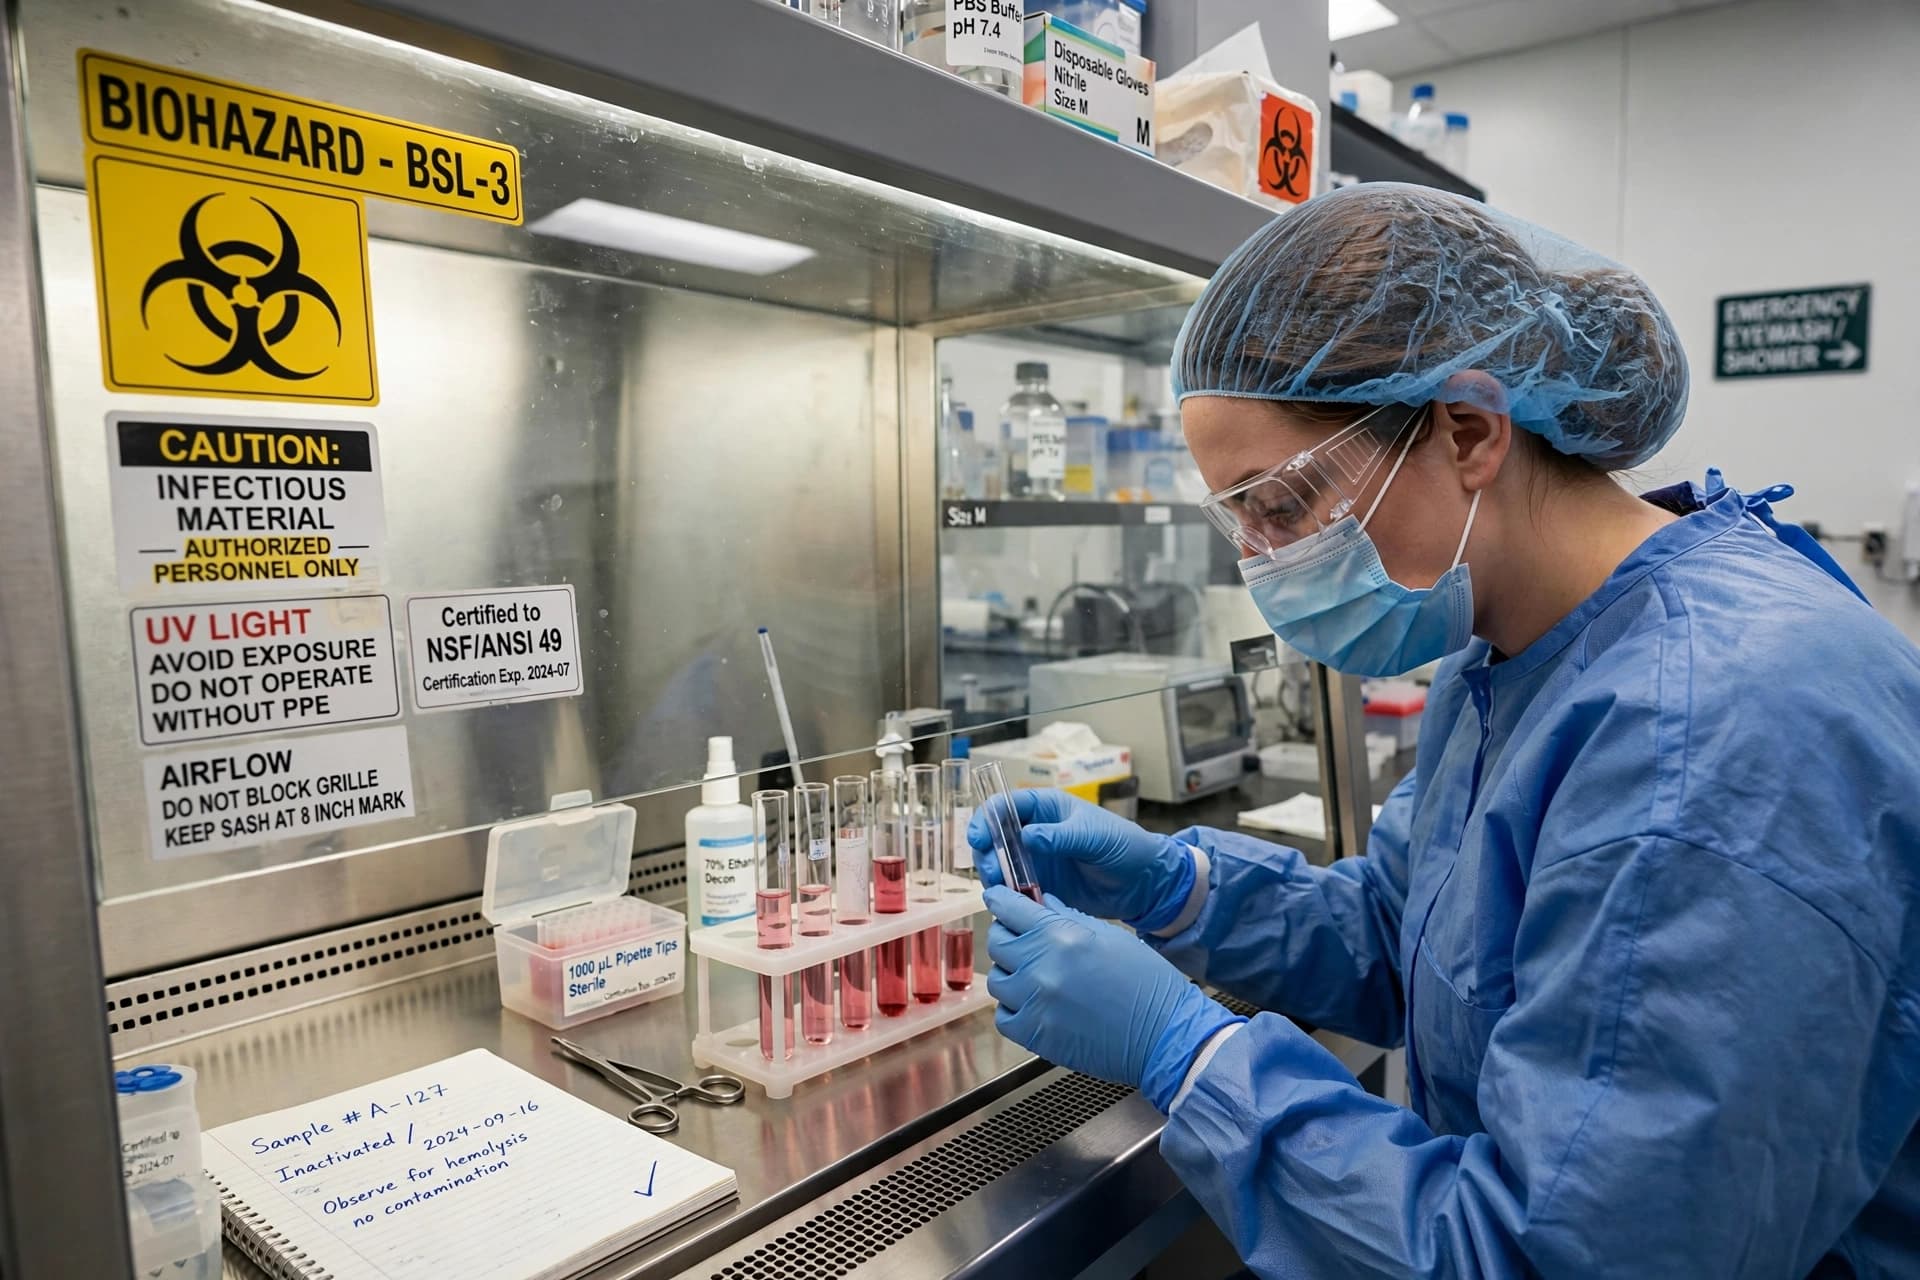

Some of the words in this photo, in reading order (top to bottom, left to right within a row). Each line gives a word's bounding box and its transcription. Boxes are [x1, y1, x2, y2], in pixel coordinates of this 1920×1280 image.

[953, 0, 987, 13] PBS
[953, 17, 975, 39] pH
[980, 19, 1001, 39] 7.4
[1054, 39, 1113, 81] Disposable
[1116, 66, 1149, 96] Gloves
[1054, 66, 1087, 93] Nitrile
[1054, 87, 1076, 112] Size
[1079, 97, 1089, 116] M
[97, 73, 365, 177] BIOHAZARD
[405, 141, 511, 206] BSL-3
[1136, 117, 1150, 147] M
[159, 428, 341, 465] CAUTION:
[157, 474, 346, 501] INFECTIOUS
[177, 506, 335, 531] MATERIAL
[184, 537, 331, 558] AUTHORIZED
[154, 560, 299, 584] PERSONNEL
[304, 558, 359, 577] ONLY
[146, 614, 196, 645] UV
[209, 608, 311, 641] LIGHT
[441, 602, 518, 627] Certified
[523, 603, 541, 622] to
[149, 648, 234, 676] AVOID
[243, 638, 377, 668] EXPOSURE
[426, 630, 534, 663] NSF/ANSI
[538, 627, 562, 653] 49
[151, 681, 191, 704] DO
[200, 675, 254, 700] NOT
[261, 664, 373, 693] OPERATE
[422, 671, 496, 692] Certification
[499, 668, 525, 686] Exp.
[527, 662, 570, 681] 2024-07
[152, 700, 276, 733] WITHOUT
[282, 694, 331, 719] PPE
[160, 749, 293, 791] AIRFLOW
[162, 797, 193, 820] DO
[199, 789, 241, 815] NOT
[246, 778, 312, 807] BLOCK
[316, 769, 379, 796] GRILLE
[164, 821, 216, 848] KEEP
[220, 813, 271, 838] SASH
[274, 808, 296, 829] AT
[300, 805, 311, 825] 8
[315, 798, 354, 823] INCH
[358, 790, 406, 816] MARK
[704, 872, 736, 885] Decon
[568, 960, 595, 980] 1000
[615, 946, 653, 967] Pipette
[655, 940, 678, 956] Tips
[568, 975, 606, 998] Sterile
[251, 1122, 334, 1155] Sample
[342, 1110, 362, 1125] #
[274, 1131, 396, 1184] Inactivated
[407, 1122, 414, 1145] /
[423, 1099, 539, 1151] 2024-09-16
[323, 1181, 399, 1215] Observe
[406, 1166, 435, 1183] for
[444, 1132, 528, 1170] hemolysis
[353, 1213, 375, 1228] no
[384, 1159, 509, 1215] contamination
